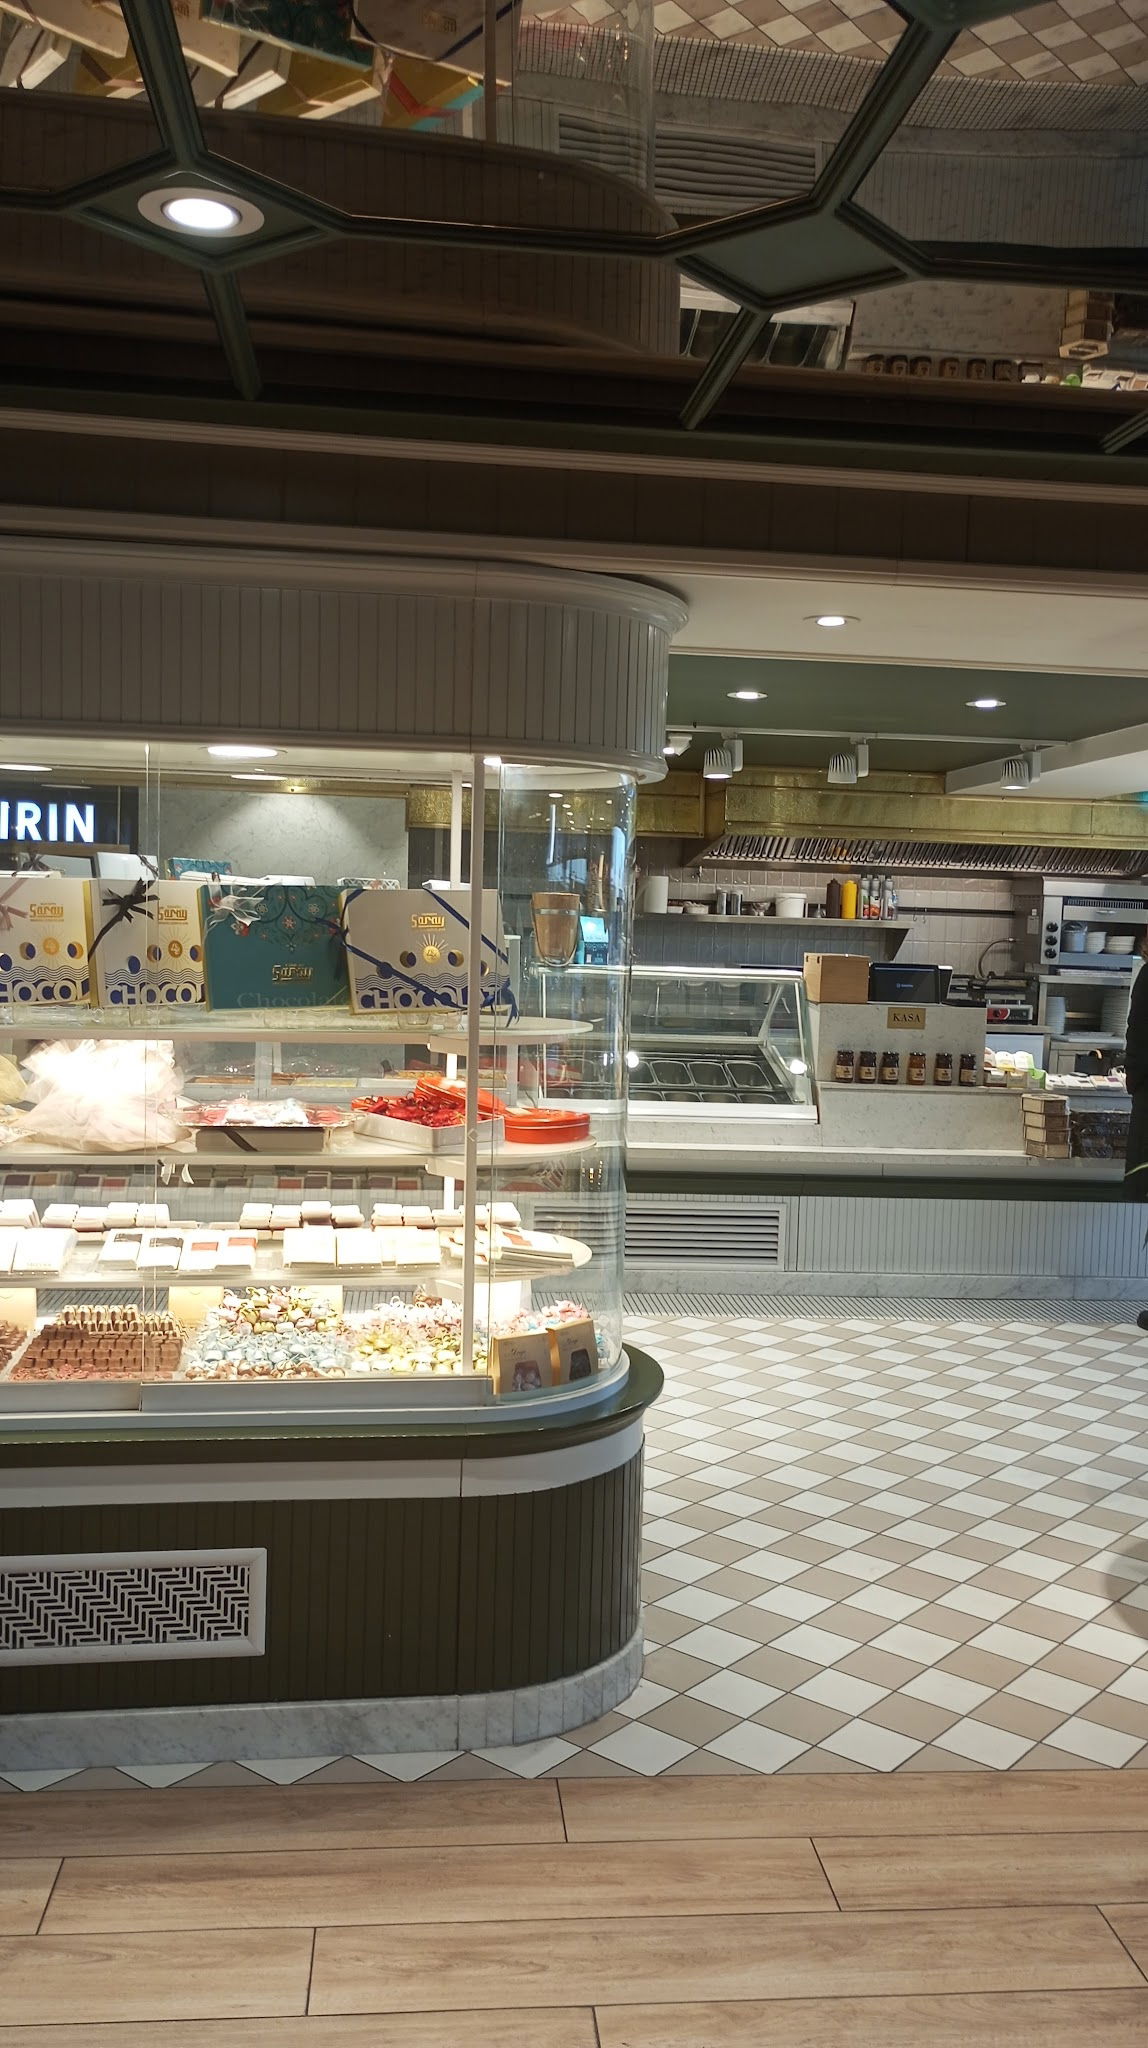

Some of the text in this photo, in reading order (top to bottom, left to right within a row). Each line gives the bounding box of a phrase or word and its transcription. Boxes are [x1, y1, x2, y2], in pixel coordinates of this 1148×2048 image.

[0, 801, 94, 842] IRIN
[29, 903, 64, 918] Saray
[411, 914, 445, 928] Saray
[893, 1013, 921, 1022] KASA
